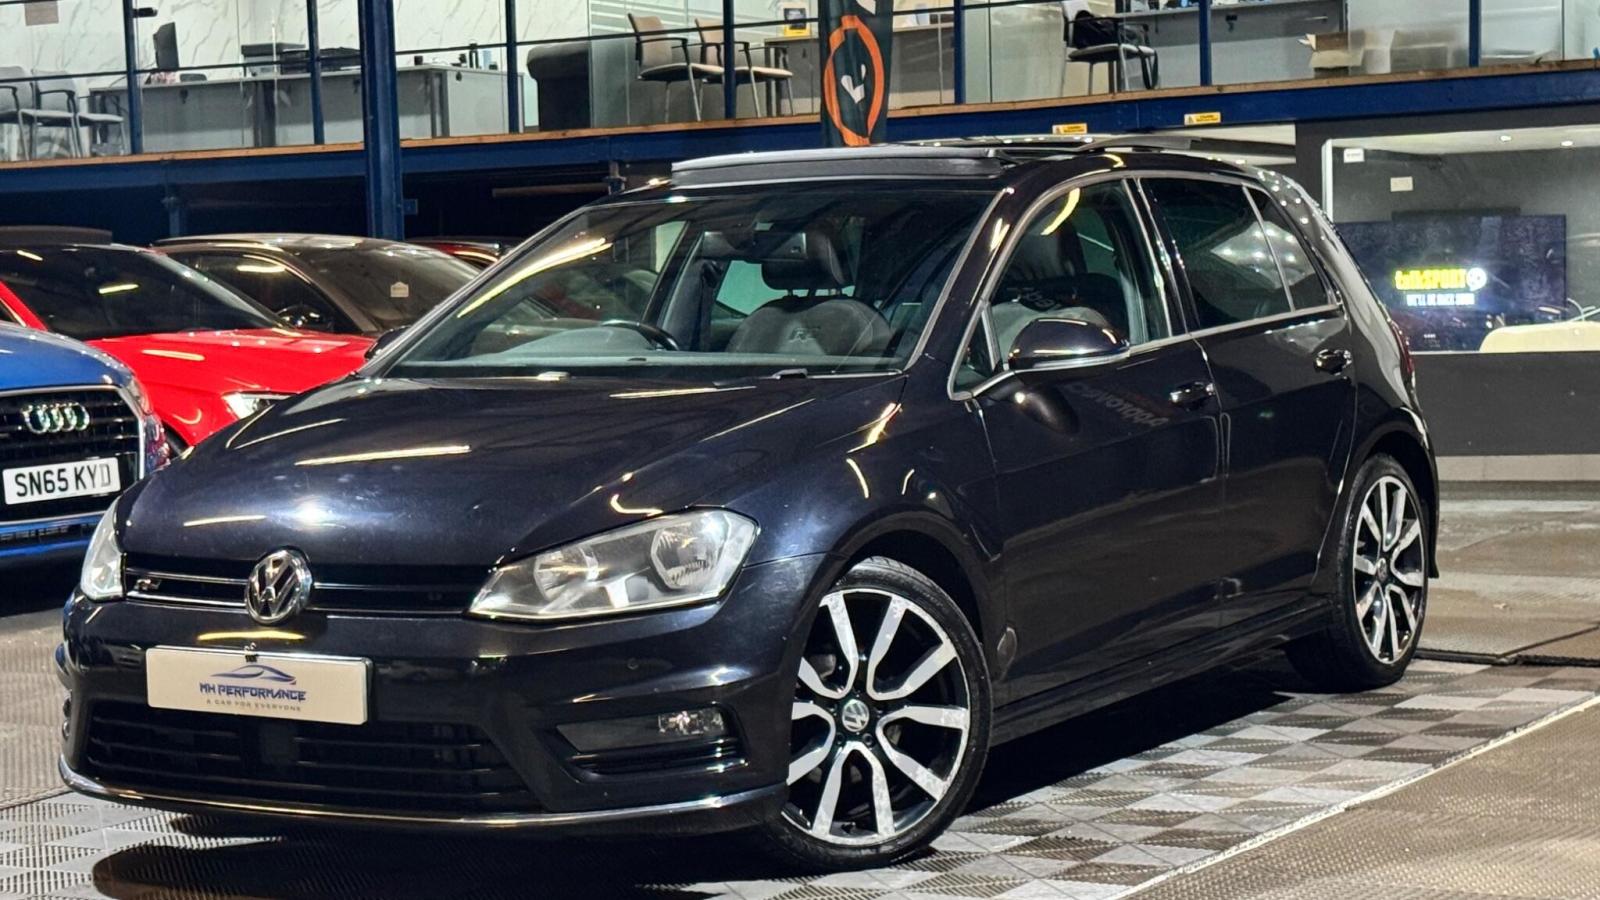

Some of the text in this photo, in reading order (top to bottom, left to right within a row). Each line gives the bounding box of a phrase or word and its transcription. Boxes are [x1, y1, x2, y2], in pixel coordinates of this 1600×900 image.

[14, 463, 111, 498] SN65 KYD
[199, 683, 307, 702] MH PERFORMANCE
[255, 702, 301, 712] EVERYONE
